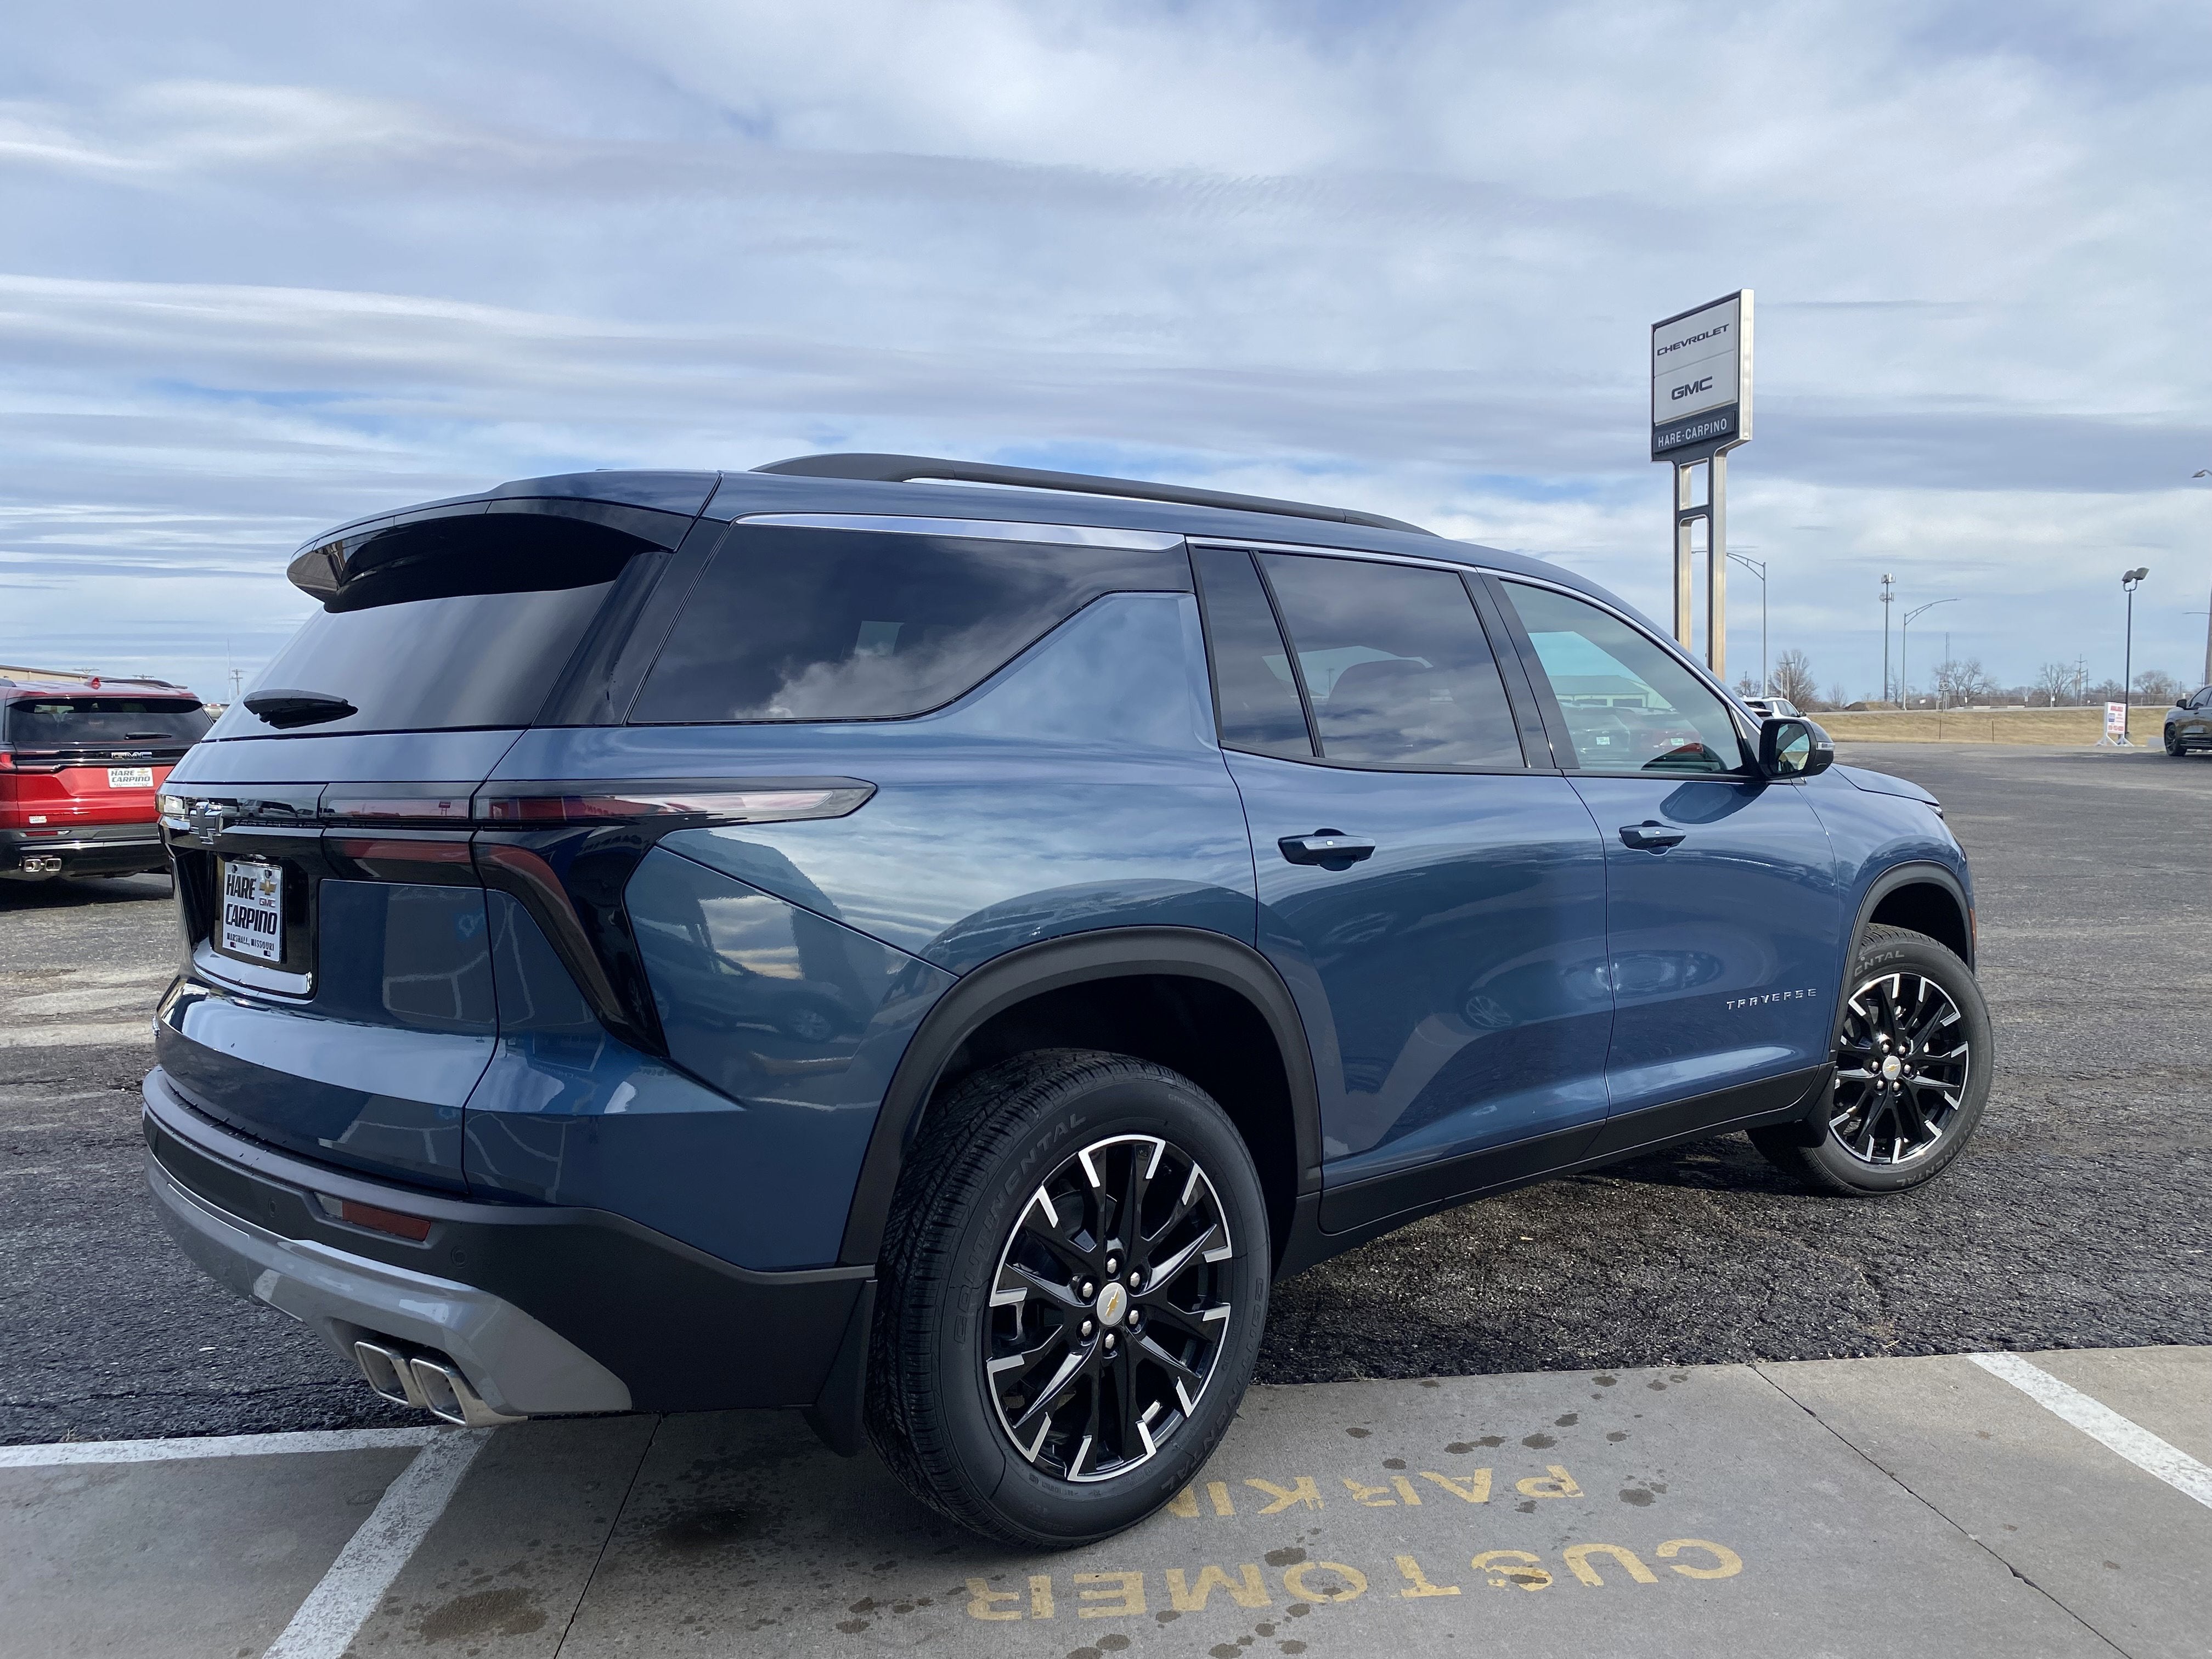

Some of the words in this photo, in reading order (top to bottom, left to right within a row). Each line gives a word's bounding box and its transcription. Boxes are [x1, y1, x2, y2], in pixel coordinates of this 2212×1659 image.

[1657, 324, 1729, 356] CHEVROLET
[1671, 376, 1713, 400] GMC
[1657, 418, 1728, 447] HARE-CARPINO
[111, 752, 153, 760] GMC
[226, 873, 257, 900] HARE
[259, 897, 276, 908] GMC
[225, 903, 278, 935] CARPINO
[1726, 988, 1816, 1010] TRAVERSE
[966, 1538, 1743, 1621] CUSTOMER
